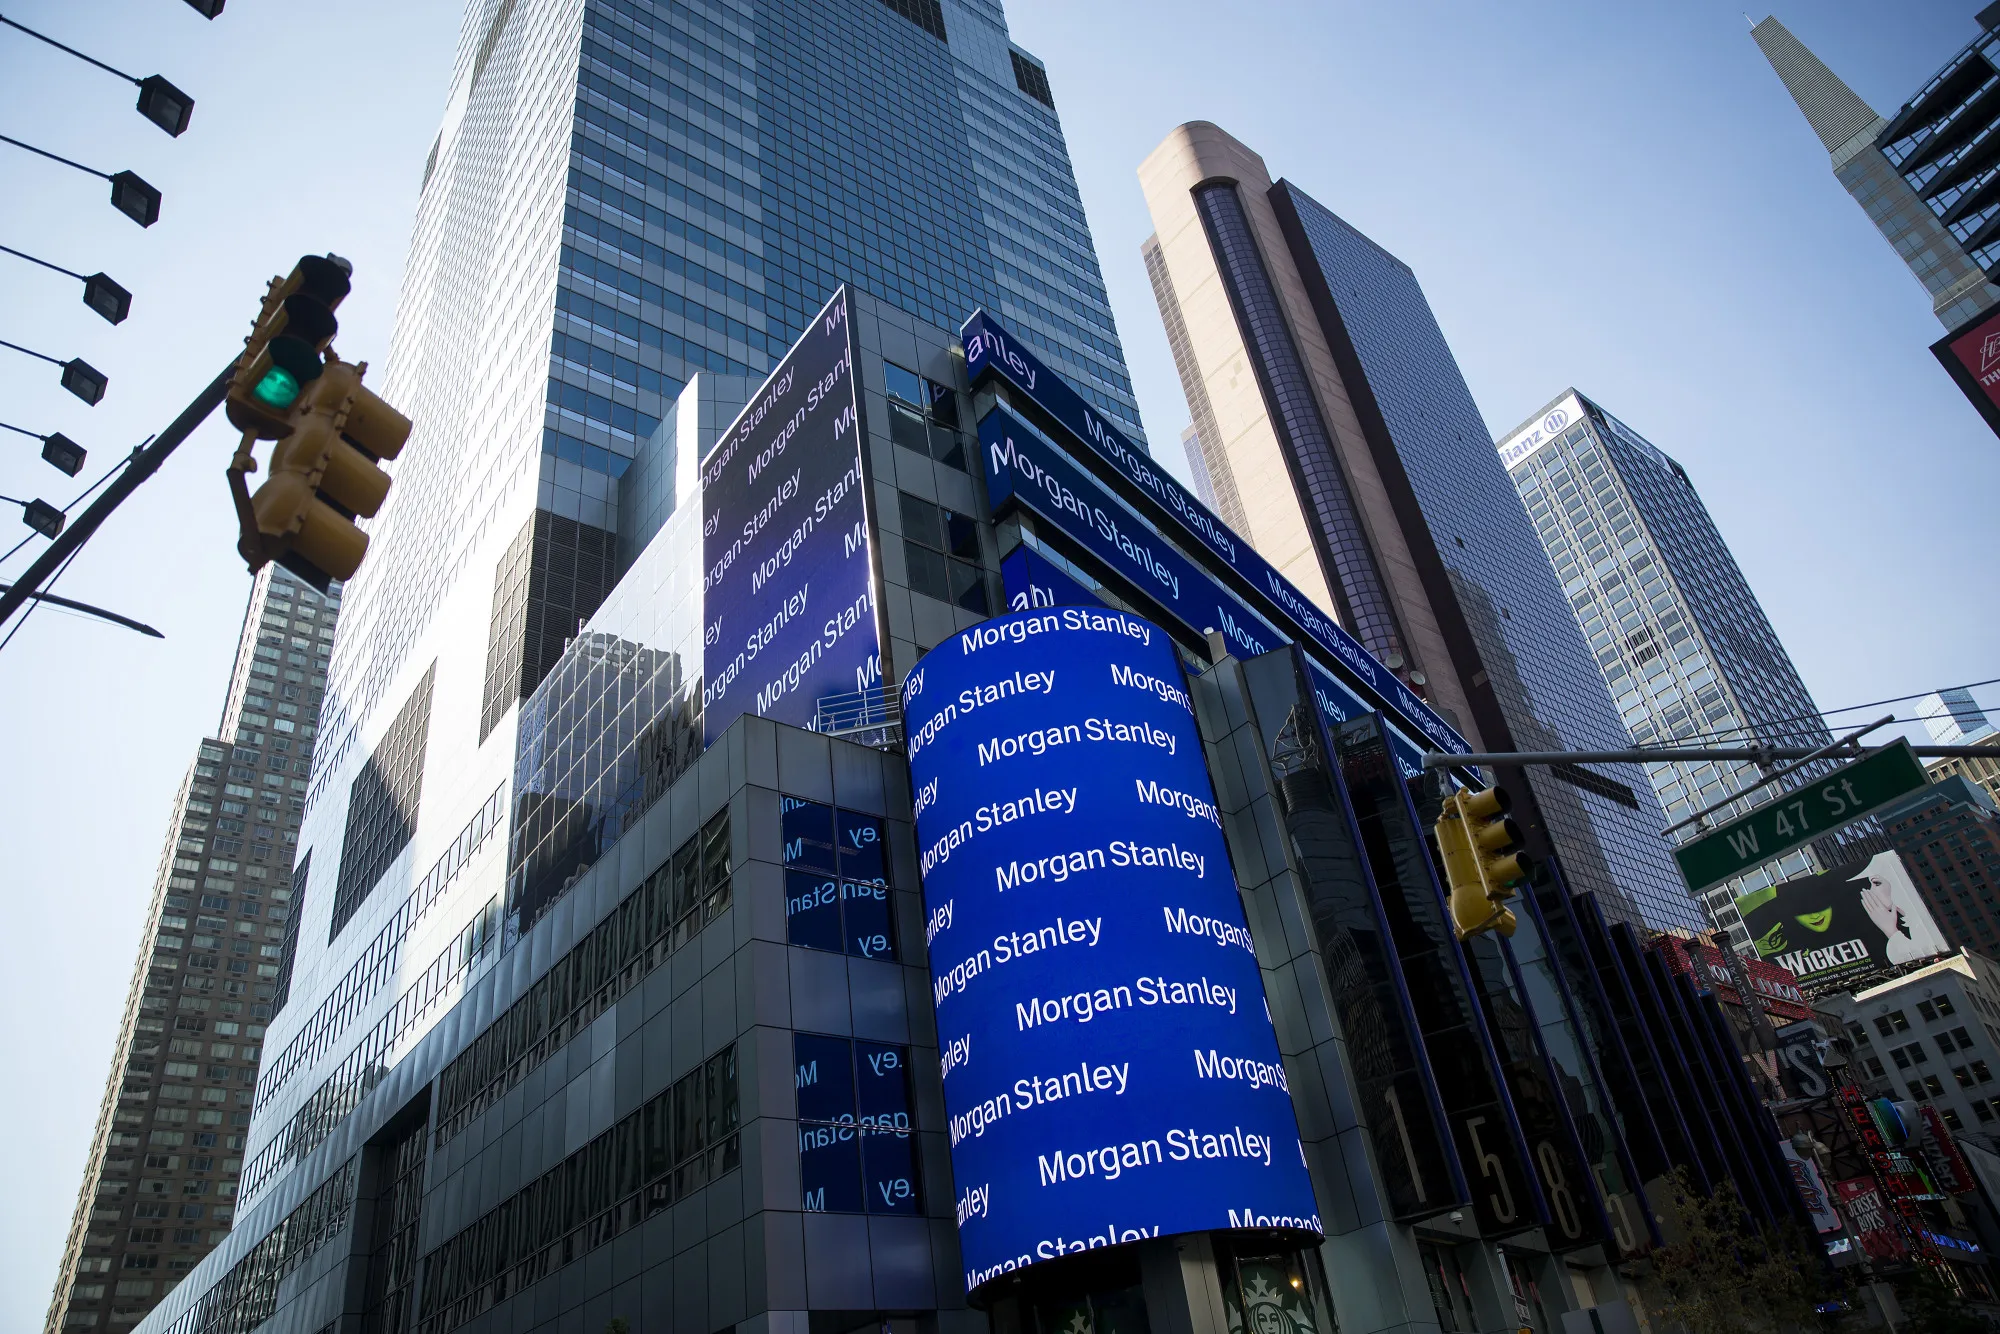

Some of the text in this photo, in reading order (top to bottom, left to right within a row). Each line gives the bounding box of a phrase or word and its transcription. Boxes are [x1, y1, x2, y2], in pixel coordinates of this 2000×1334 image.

[967, 328, 1036, 390] anley
[702, 365, 795, 491] organ Stanley
[748, 406, 805, 485] Morgan
[807, 347, 851, 412] Stanl
[1500, 430, 1543, 466] lianz
[1083, 409, 1236, 563] Morgan Stanley
[703, 467, 800, 594] organ Stanley
[752, 516, 813, 595] Morgan
[815, 455, 863, 522] Stanl
[990, 437, 1179, 599] Morgan Stanley
[704, 583, 809, 709] organ Stanley
[757, 639, 821, 716] Morgan
[824, 580, 876, 649] Stanl
[961, 609, 1150, 655] Morgan Stanley
[1266, 570, 1377, 685] Morgan Stanley
[902, 667, 925, 711] nley
[1110, 663, 1187, 706] Morgan
[907, 670, 1055, 765] Morgan Stanley
[1396, 685, 1442, 740] Morgan
[977, 718, 1176, 767] Morgan Stanley
[912, 777, 938, 826] nley
[1135, 779, 1212, 825] Morgan
[1726, 777, 1863, 860] W 47 St
[920, 821, 973, 882] Morgan
[975, 787, 1078, 833] Stanley
[995, 841, 1205, 893] Morgan Stanley
[925, 898, 954, 948] anley
[1163, 906, 1244, 949] Morgan
[934, 917, 1102, 1009] Morgan Stanley
[1691, 954, 1711, 992] HERS
[1016, 985, 1133, 1032] Morgan
[1136, 976, 1236, 1015] Stanley
[940, 1033, 971, 1081] anley
[1194, 1049, 1278, 1090] Morgan
[949, 1062, 1129, 1148] Morgan Stanley
[1038, 1137, 1163, 1187] Morgan
[1166, 1125, 1271, 1167] Stanley
[956, 1183, 989, 1230] anley
[1849, 1190, 1882, 1219] JERSEY
[1858, 1210, 1886, 1233] BOYS
